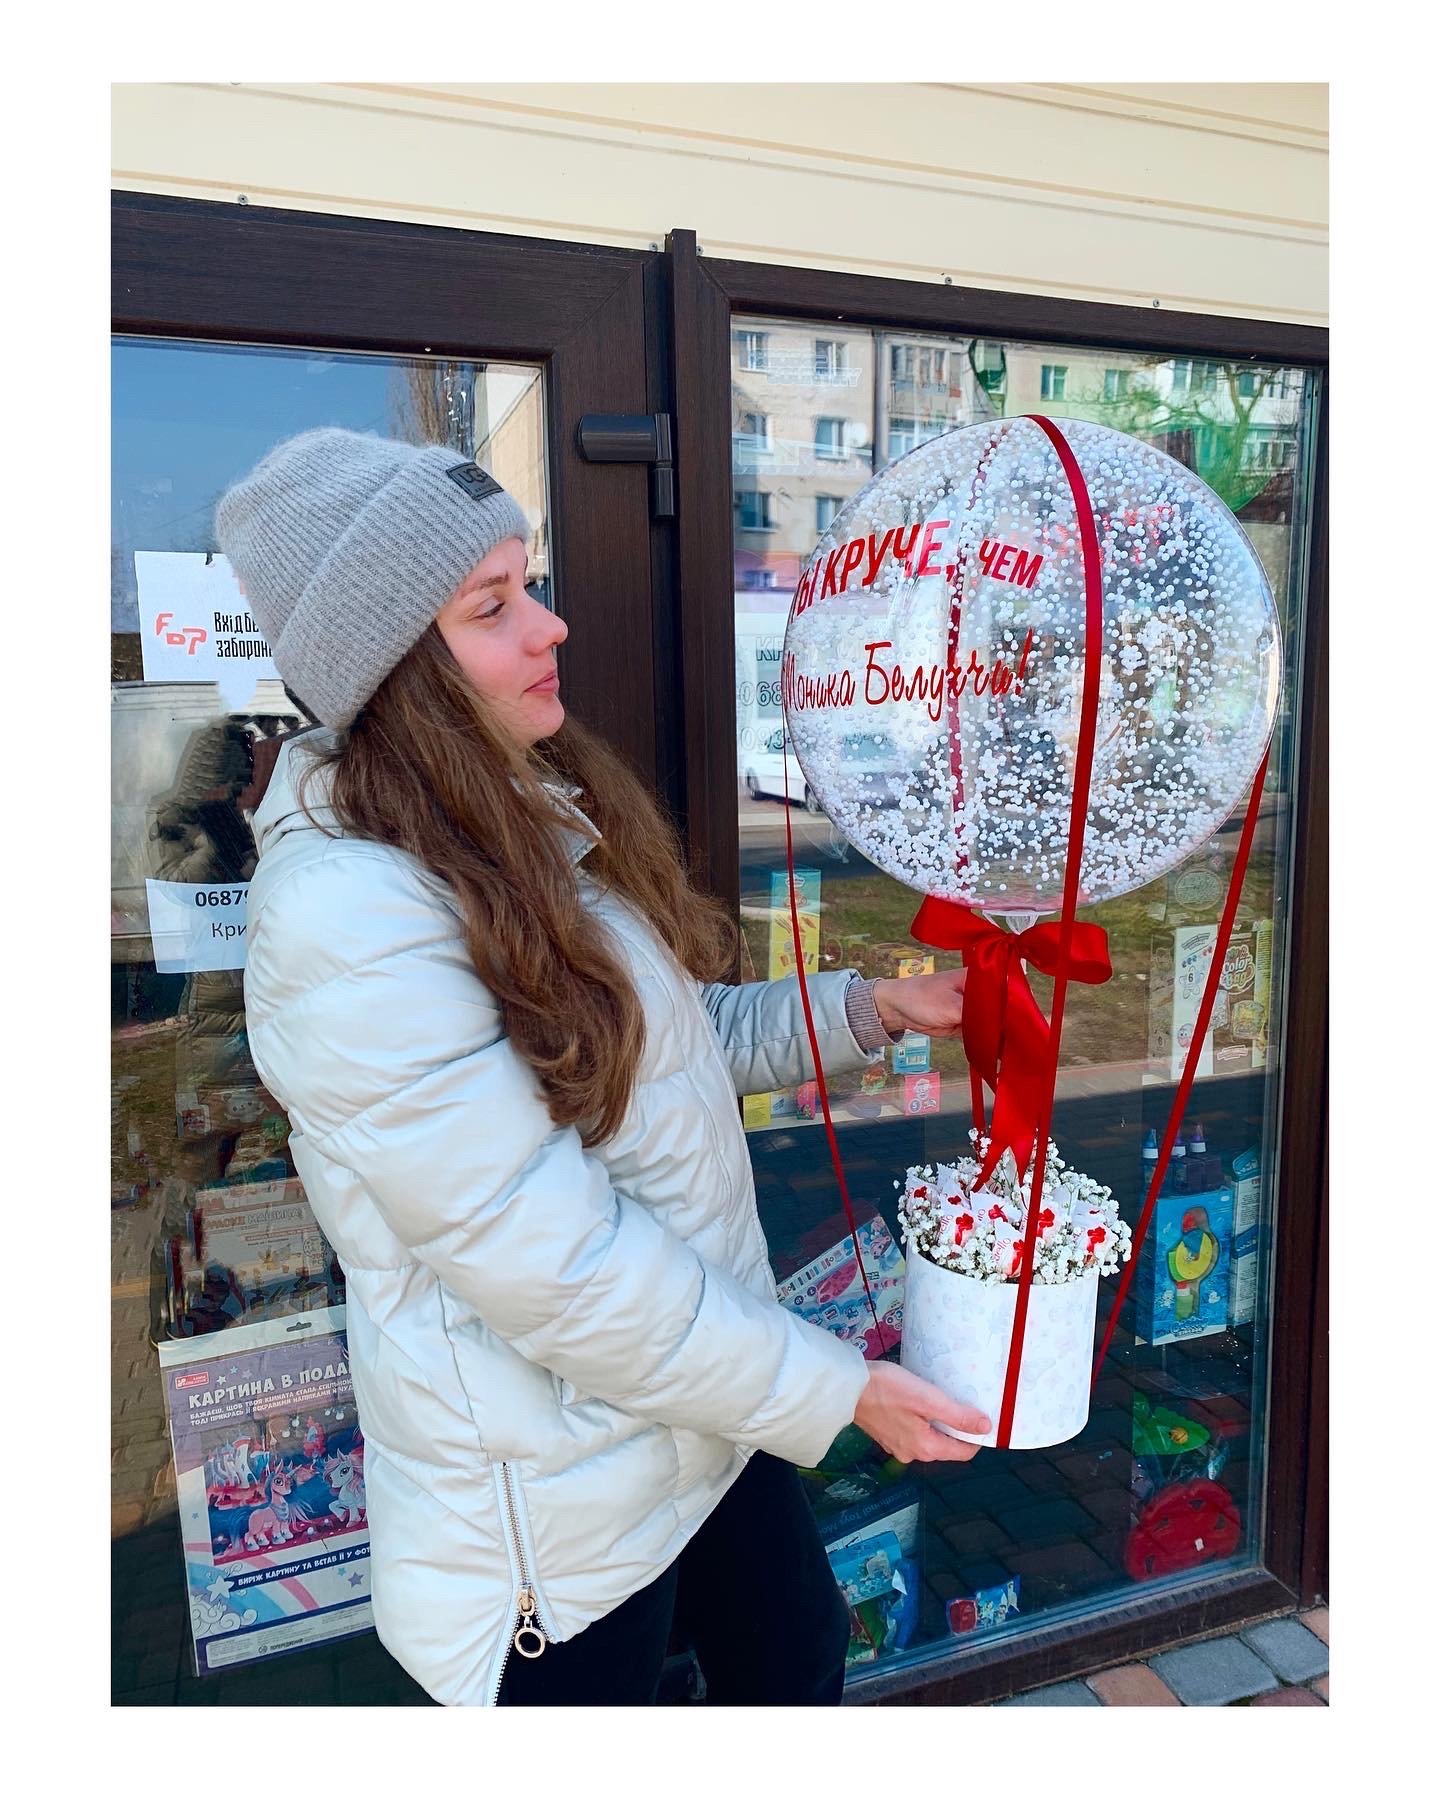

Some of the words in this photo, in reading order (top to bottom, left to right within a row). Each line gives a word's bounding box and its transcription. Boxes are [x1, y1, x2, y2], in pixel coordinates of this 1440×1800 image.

[820, 519, 956, 601] КРУЧЕ,
[978, 538, 1044, 590] ЧЕМ
[213, 612, 243, 634] Вхід
[782, 650, 856, 712] Моника
[188, 1377, 276, 1409] КАРТИНА
[281, 1374, 294, 1389] В
[300, 1361, 349, 1384] ПОДА
[238, 1573, 264, 1587] ВИРІЖ
[266, 1565, 301, 1580] КАРТИНУ
[302, 1561, 313, 1571] ТА
[314, 1555, 337, 1568] ВСТАВ
[346, 1551, 353, 1559] У
